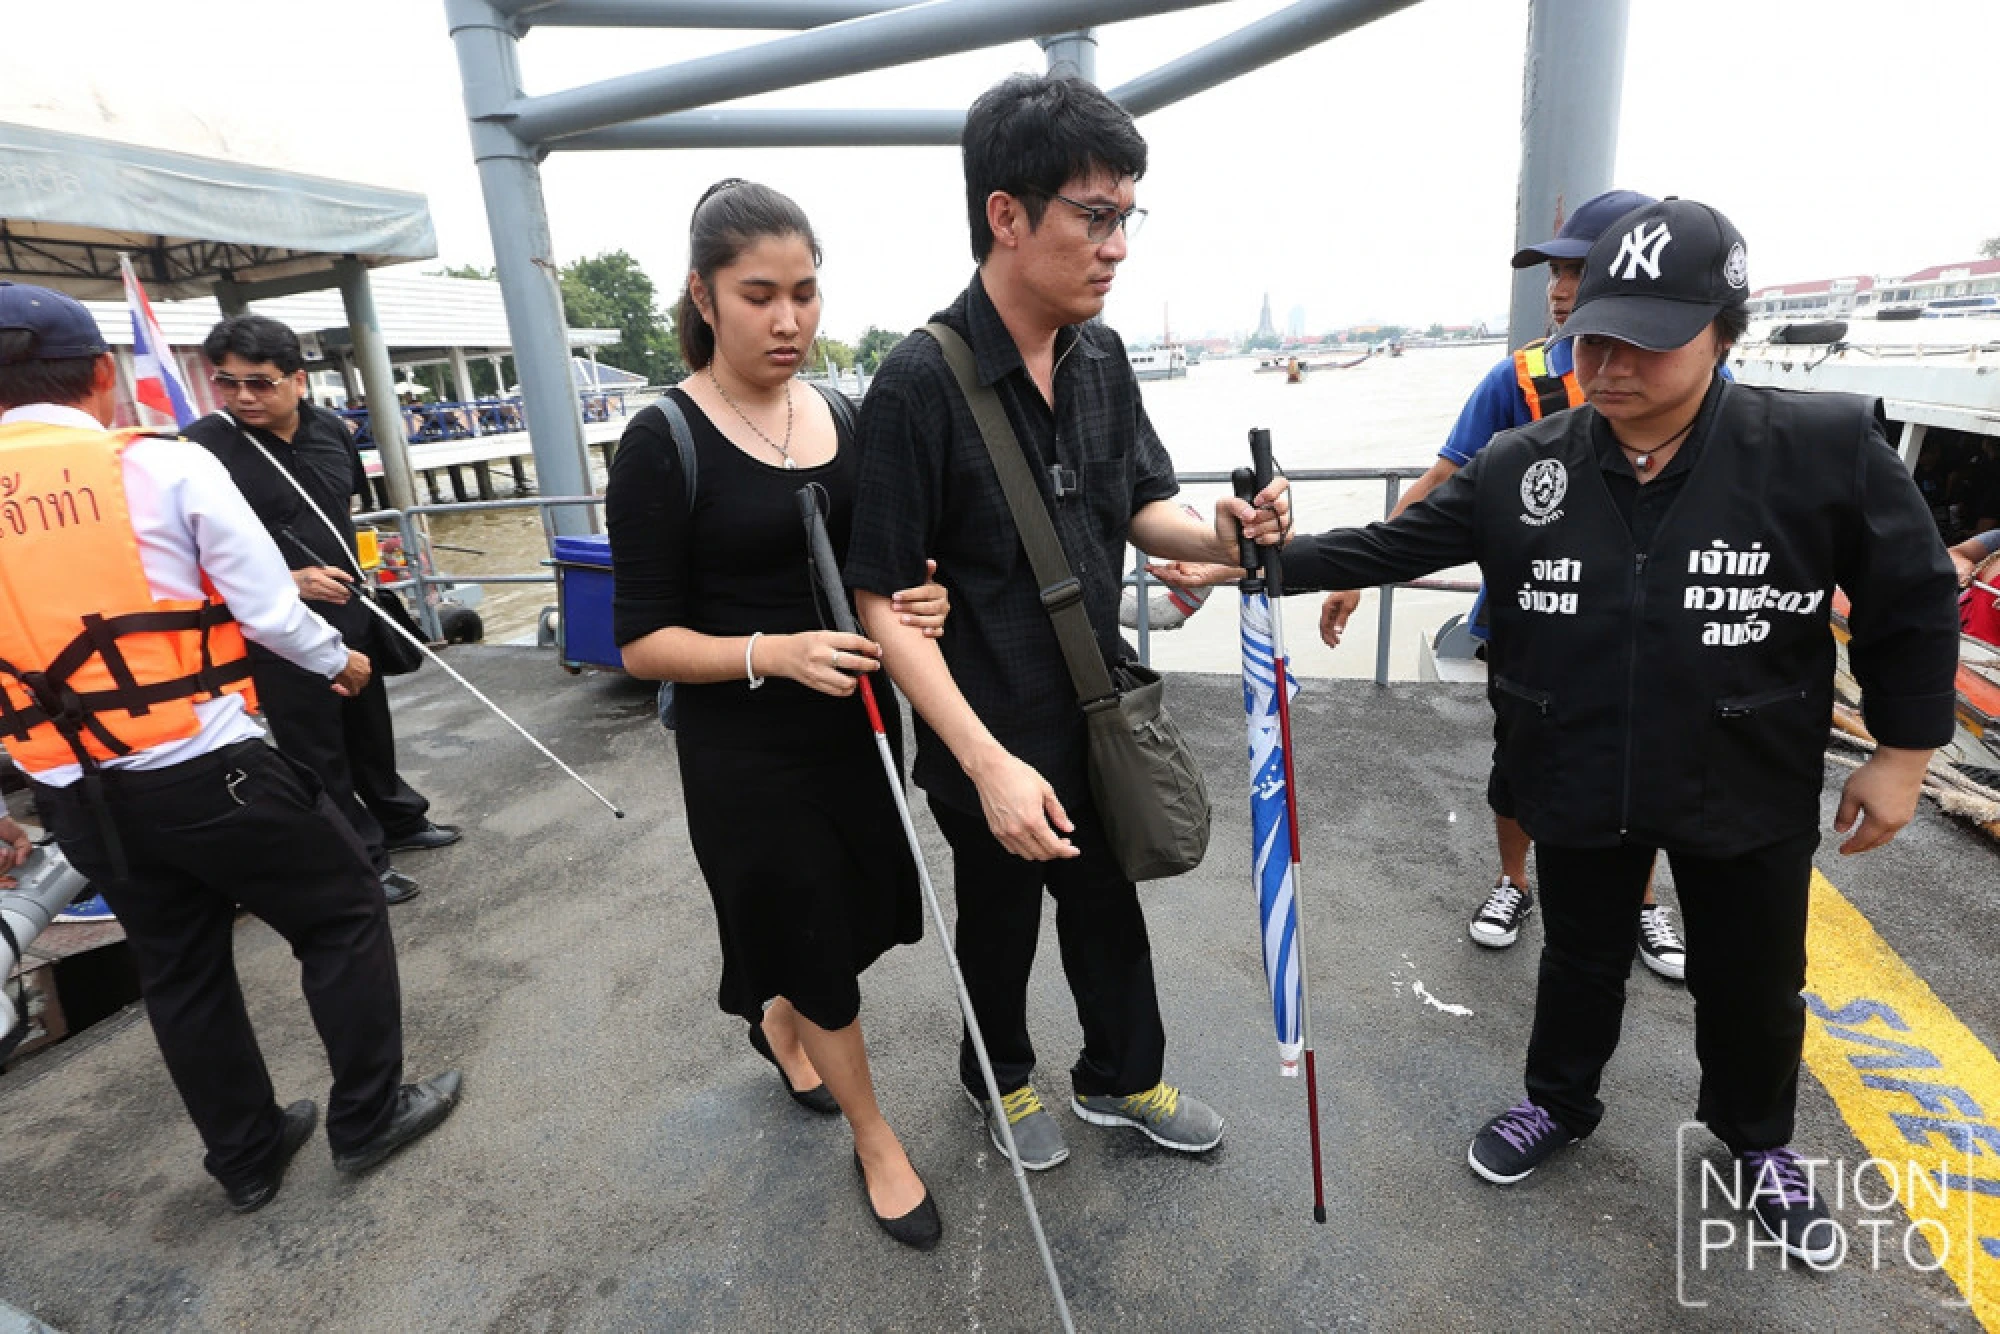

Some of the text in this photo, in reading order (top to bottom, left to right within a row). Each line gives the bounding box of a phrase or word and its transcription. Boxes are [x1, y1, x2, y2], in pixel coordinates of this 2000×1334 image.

[1608, 222, 1672, 280] NY
[0, 467, 101, 539] จ้าท่า
